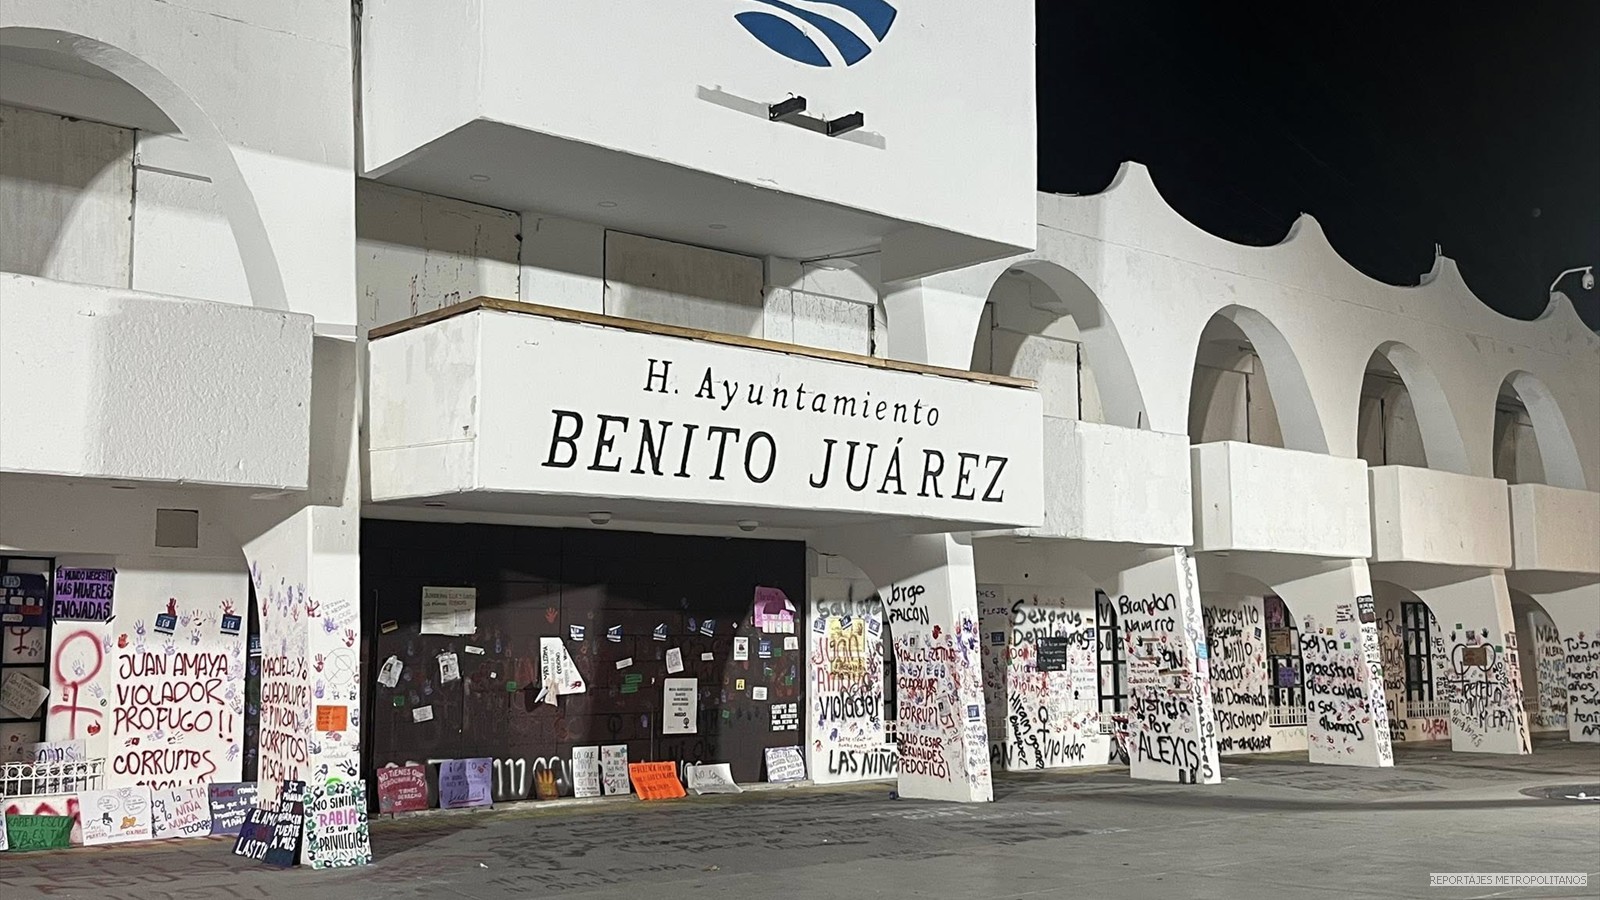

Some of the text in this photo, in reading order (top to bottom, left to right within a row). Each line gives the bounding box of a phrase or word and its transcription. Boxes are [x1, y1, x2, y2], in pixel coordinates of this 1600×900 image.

[643, 358, 940, 427] H. Ayuntamiento
[541, 409, 1009, 503] BENITO JUÁREZ
[73, 582, 113, 599] MUJERES
[54, 600, 111, 620] ENOJADAS
[1118, 593, 1177, 616] Brandon
[1124, 616, 1175, 633] Navarro
[119, 652, 229, 679] JUAN AMAYA
[117, 679, 225, 706] VIOLADOR
[1306, 680, 1330, 697] que
[1130, 688, 1190, 720] Justicia
[1148, 713, 1171, 733] Por
[1138, 731, 1199, 772] ALEXIS
[828, 749, 858, 776] LAS
[175, 800, 202, 817] NIÑA
[313, 800, 327, 812] NO
[168, 812, 200, 830] NUNCA
[250, 809, 261, 824] EL
[317, 808, 358, 828] RABIA
[274, 824, 300, 838] FUERTE
[270, 838, 277, 850] A
